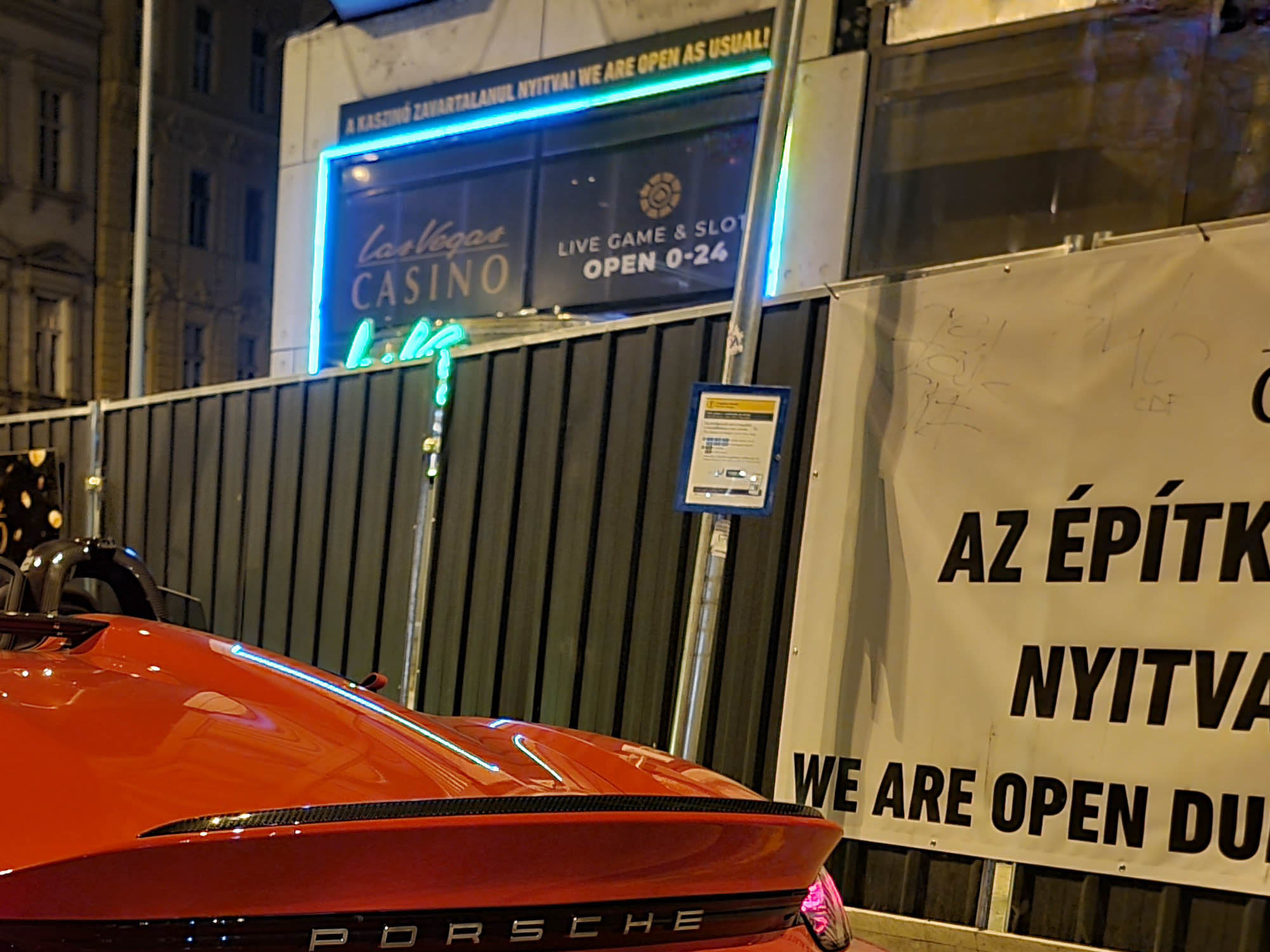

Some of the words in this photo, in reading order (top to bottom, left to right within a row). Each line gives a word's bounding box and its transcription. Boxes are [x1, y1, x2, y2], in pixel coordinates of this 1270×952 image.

[345, 118, 355, 135] A
[357, 101, 412, 133] KASZINÓ
[413, 83, 516, 121] ZAVARTALANUL
[518, 71, 576, 99] NYITVA!
[578, 64, 602, 87] WE
[604, 58, 636, 79] ARE
[637, 46, 680, 74] OPEN
[683, 40, 706, 65] AS
[709, 26, 771, 59] USUAL!
[416, 219, 506, 260] Vegas
[558, 236, 601, 257] LIVE
[607, 226, 667, 250] GAME
[673, 224, 687, 241] &
[583, 251, 656, 280] OPEN
[666, 240, 728, 269] 0-24
[351, 254, 509, 311] CASINO
[937, 509, 1029, 582] AZ
[1045, 479, 1270, 582] ÉPÍTK
[1009, 644, 1270, 731] NYITVA
[793, 752, 862, 813] WE
[871, 762, 976, 827] ARE
[991, 772, 1149, 848] OPEN
[1168, 788, 1270, 864] DU
[308, 909, 704, 952] PORSCHE
